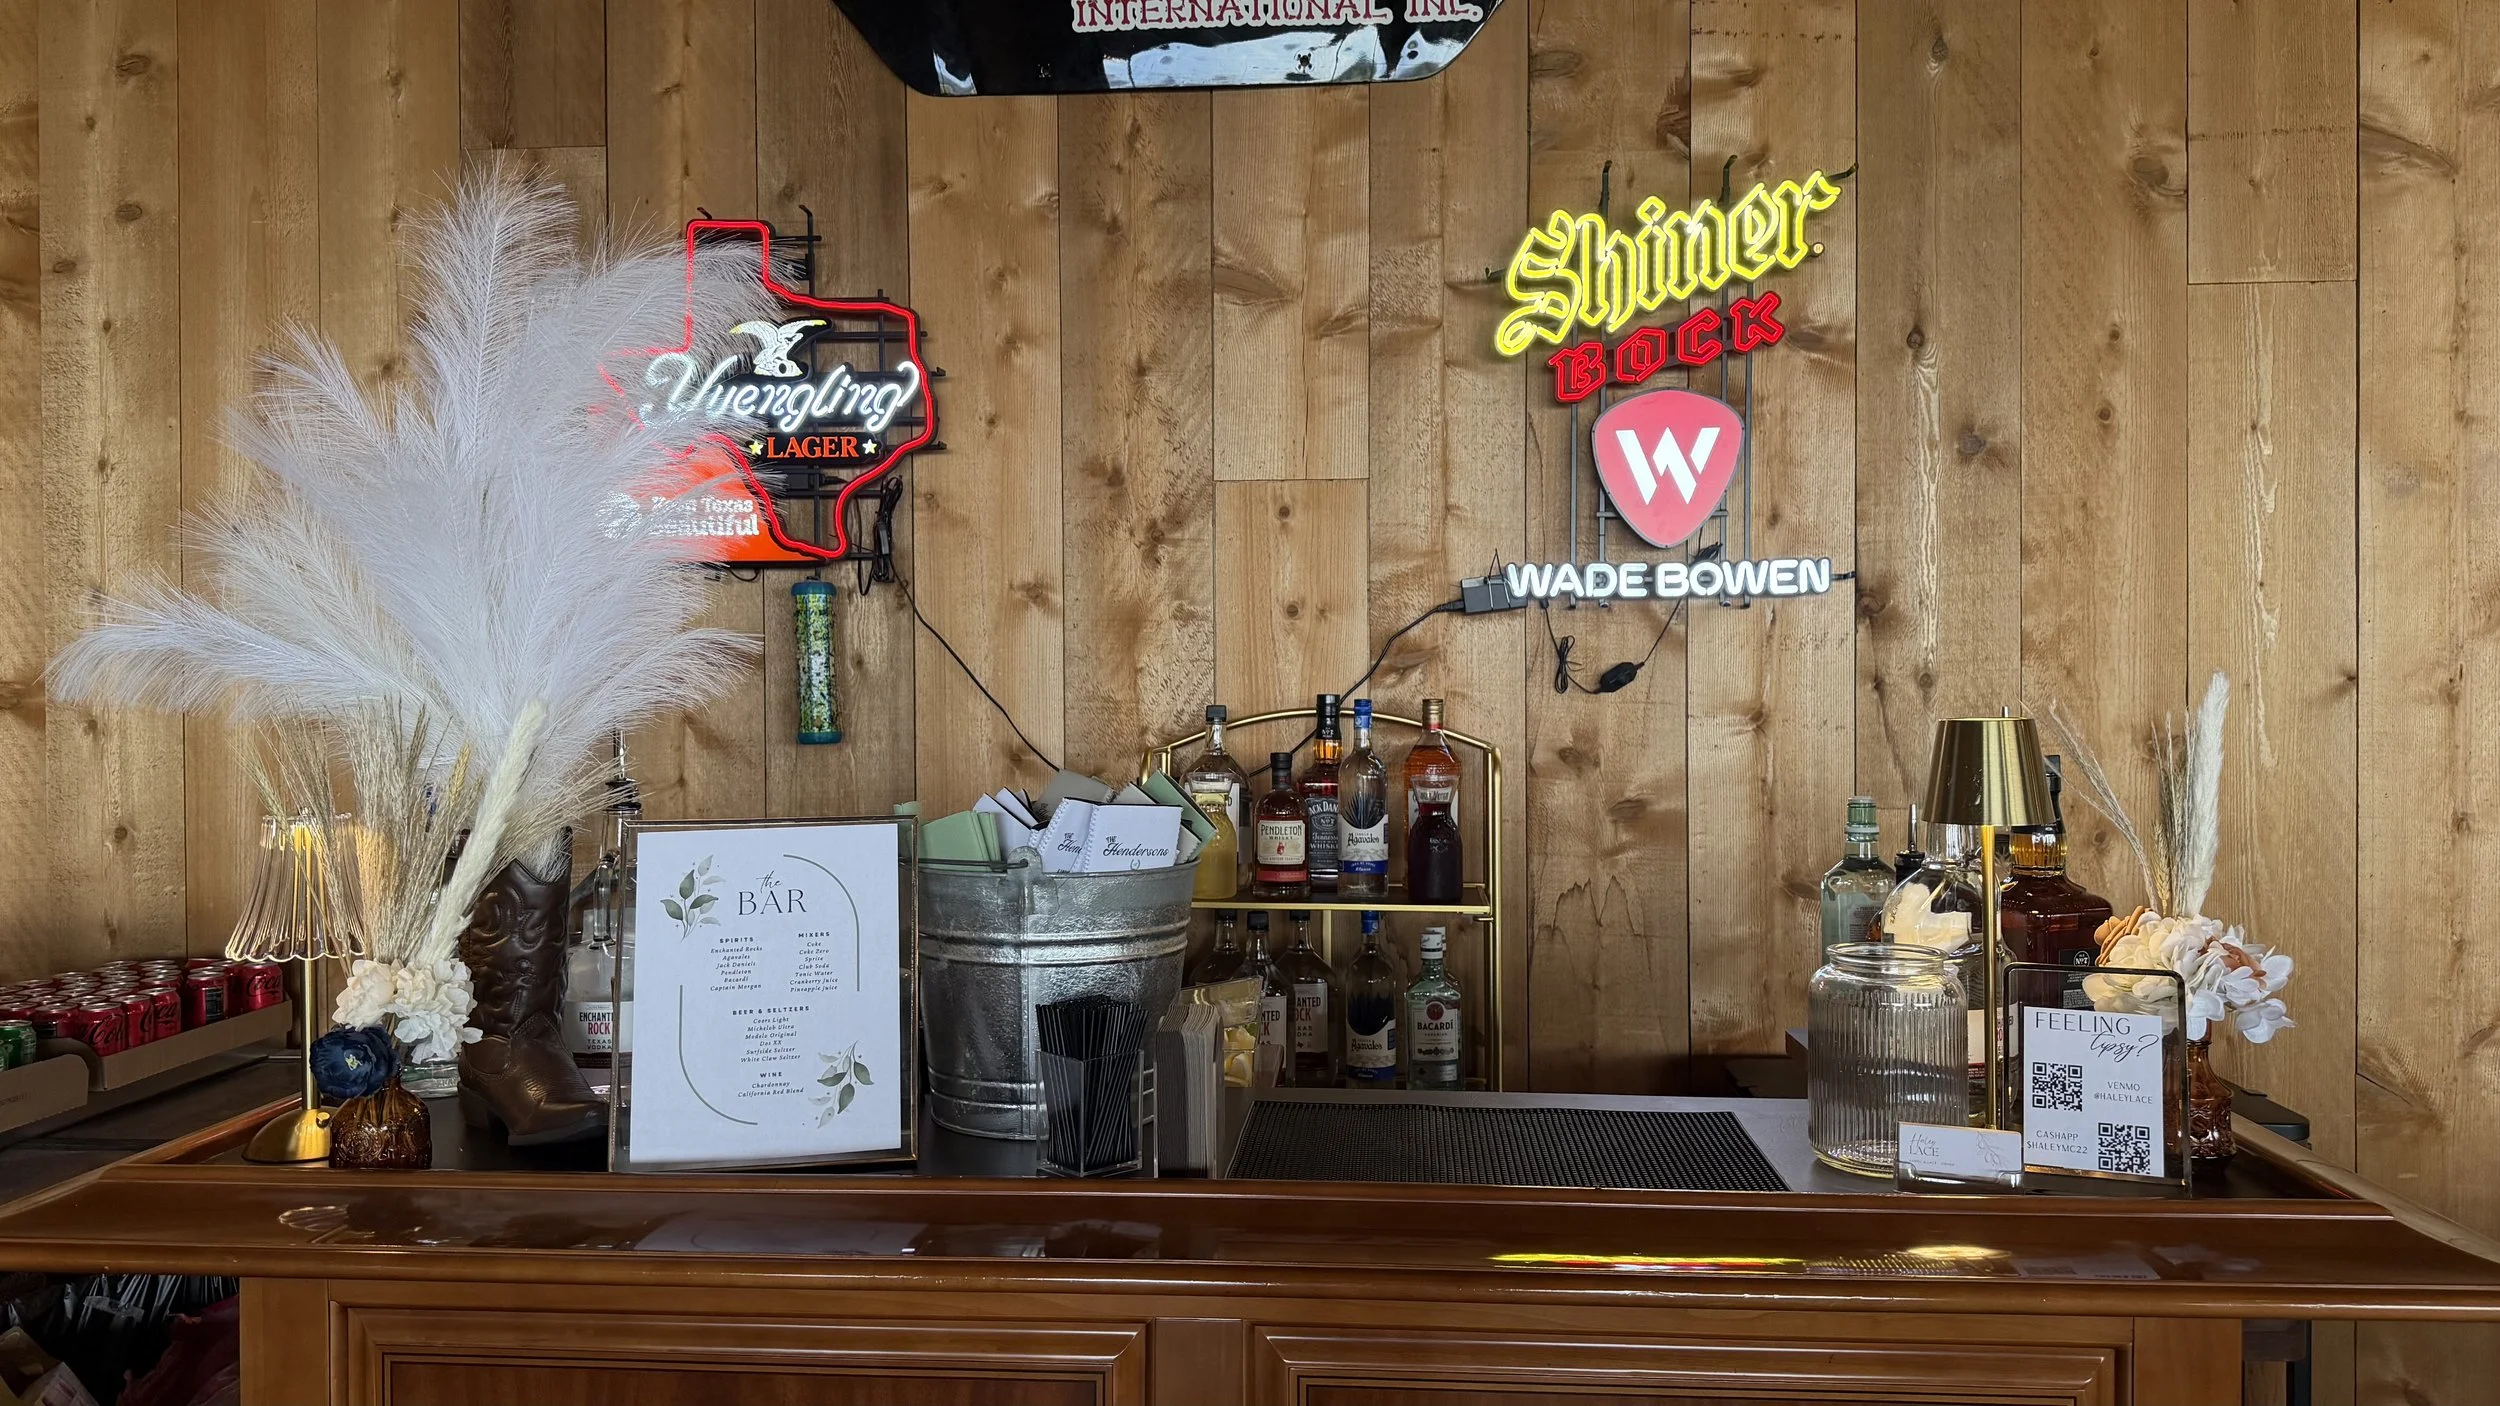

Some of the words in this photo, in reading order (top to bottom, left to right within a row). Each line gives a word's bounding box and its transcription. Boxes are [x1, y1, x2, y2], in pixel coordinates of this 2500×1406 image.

[1075, 0, 1389, 29] INTERNATIONAL
[1408, 0, 1480, 18] INC.
[1495, 170, 1842, 356] Shiner
[1546, 290, 1785, 403] BOCK
[637, 351, 920, 433] Yuengling
[767, 436, 859, 459] LAGER
[1505, 562, 1649, 598] WADE
[1655, 557, 1832, 597] BOWEN
[1260, 824, 1303, 836] PENDLETON
[1105, 835, 1118, 843] THE
[1346, 832, 1380, 848] Agavales
[1102, 842, 1170, 857] Hendersons
[755, 870, 783, 894] the
[738, 888, 808, 916] BAR
[719, 936, 754, 944] SPIRITS
[710, 946, 744, 954] Enchanted
[715, 962, 730, 970] Jack
[732, 960, 756, 968] Daniels
[720, 968, 752, 976] Pendleton
[821, 977, 839, 985] Juice
[710, 984, 735, 992] Captain
[790, 985, 821, 993] Pineapple
[821, 984, 838, 992] Juice
[1296, 996, 1321, 1008] ANTED
[767, 1005, 810, 1013] SELTZERS
[579, 1011, 613, 1022] ENCHANT
[772, 1016, 789, 1024] Light
[588, 1022, 611, 1035] ROCK
[747, 1024, 776, 1032] Michelob
[2035, 1011, 2131, 1036] FEELING
[745, 1032, 768, 1040] Modelo
[751, 1081, 791, 1089] Chardonnay
[2107, 1081, 2141, 1091] VENMO
[737, 1089, 771, 1098] California
[2093, 1092, 2153, 1105] @HALEYLACE
[2036, 1130, 2079, 1140] CASHAPP
[1909, 1145, 1940, 1157] LACE
[2026, 1140, 2088, 1154] $HALEYMC22
